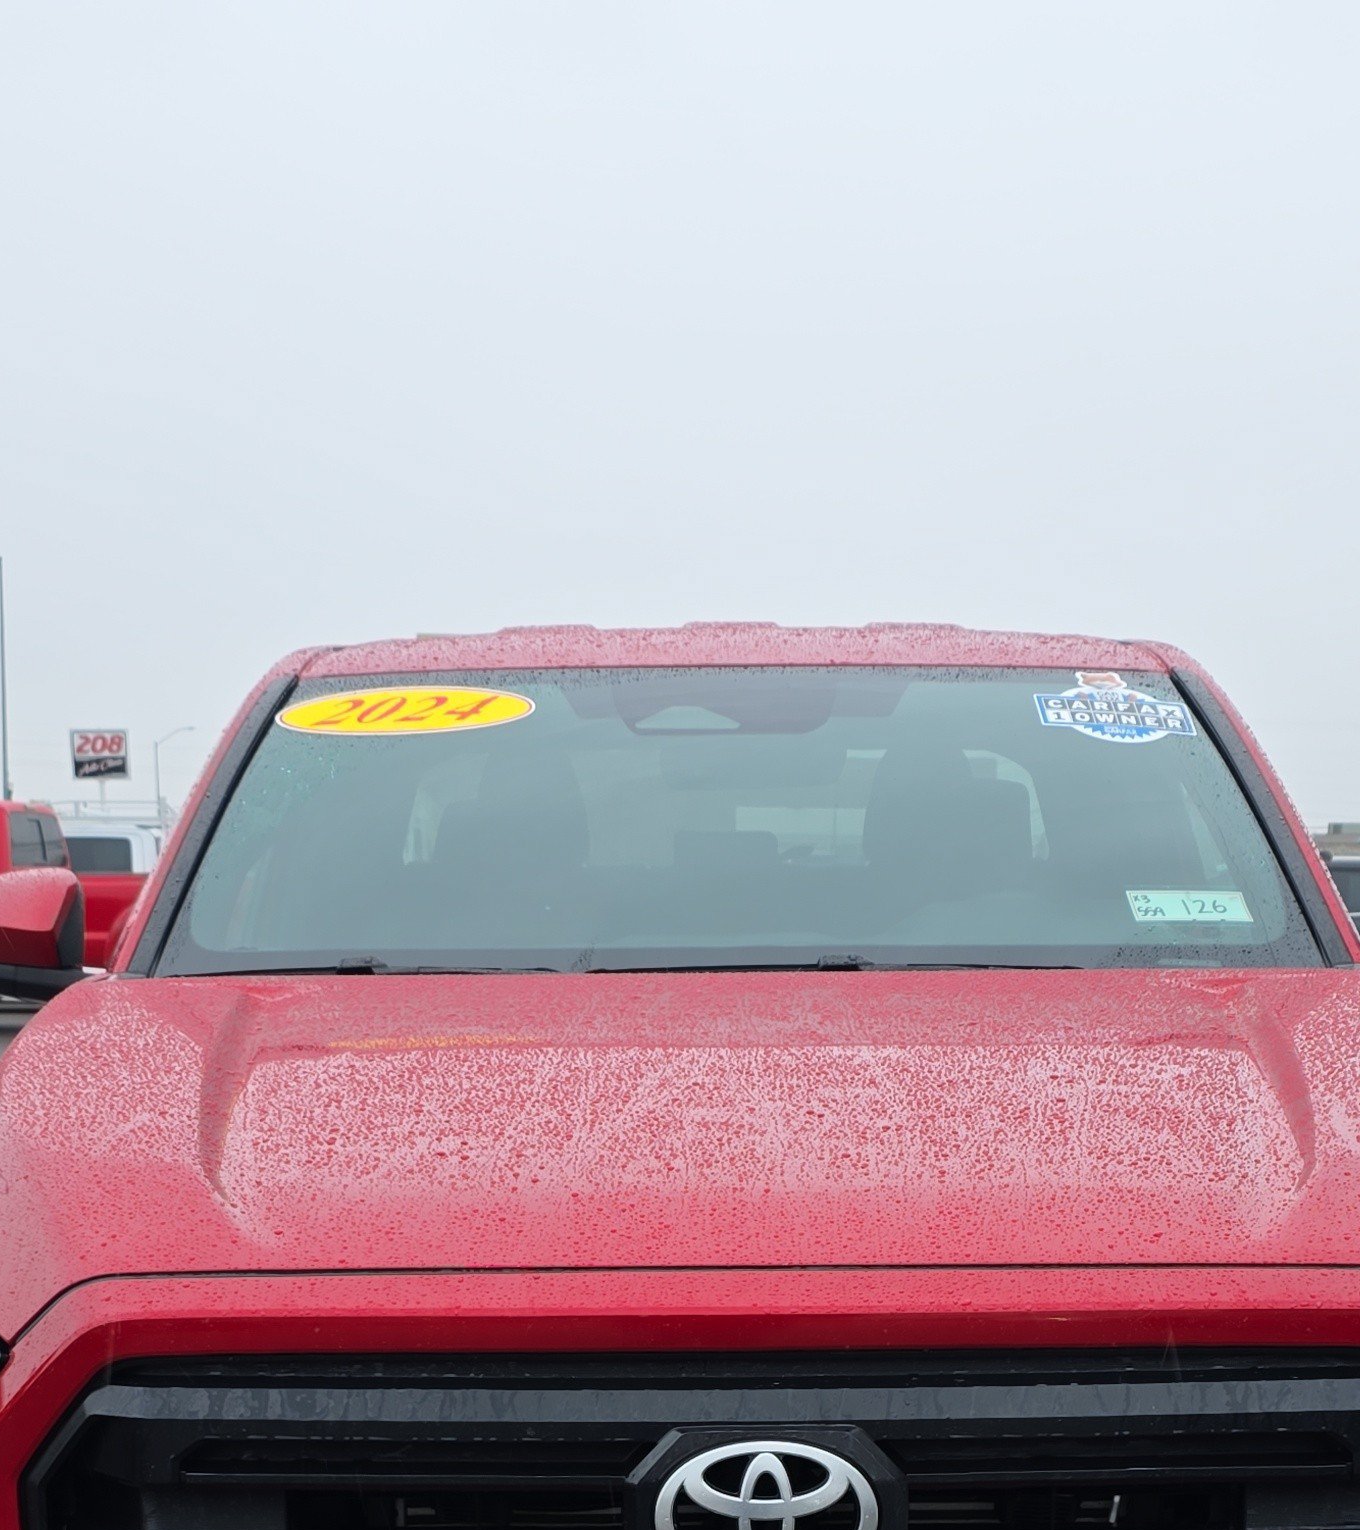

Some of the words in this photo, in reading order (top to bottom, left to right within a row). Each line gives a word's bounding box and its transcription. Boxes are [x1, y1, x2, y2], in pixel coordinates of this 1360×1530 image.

[310, 696, 500, 727] 2024
[1046, 699, 1184, 718] CARFAX
[1074, 712, 1183, 729] OWNER
[76, 734, 124, 754] 208
[1181, 899, 1227, 915] 126
